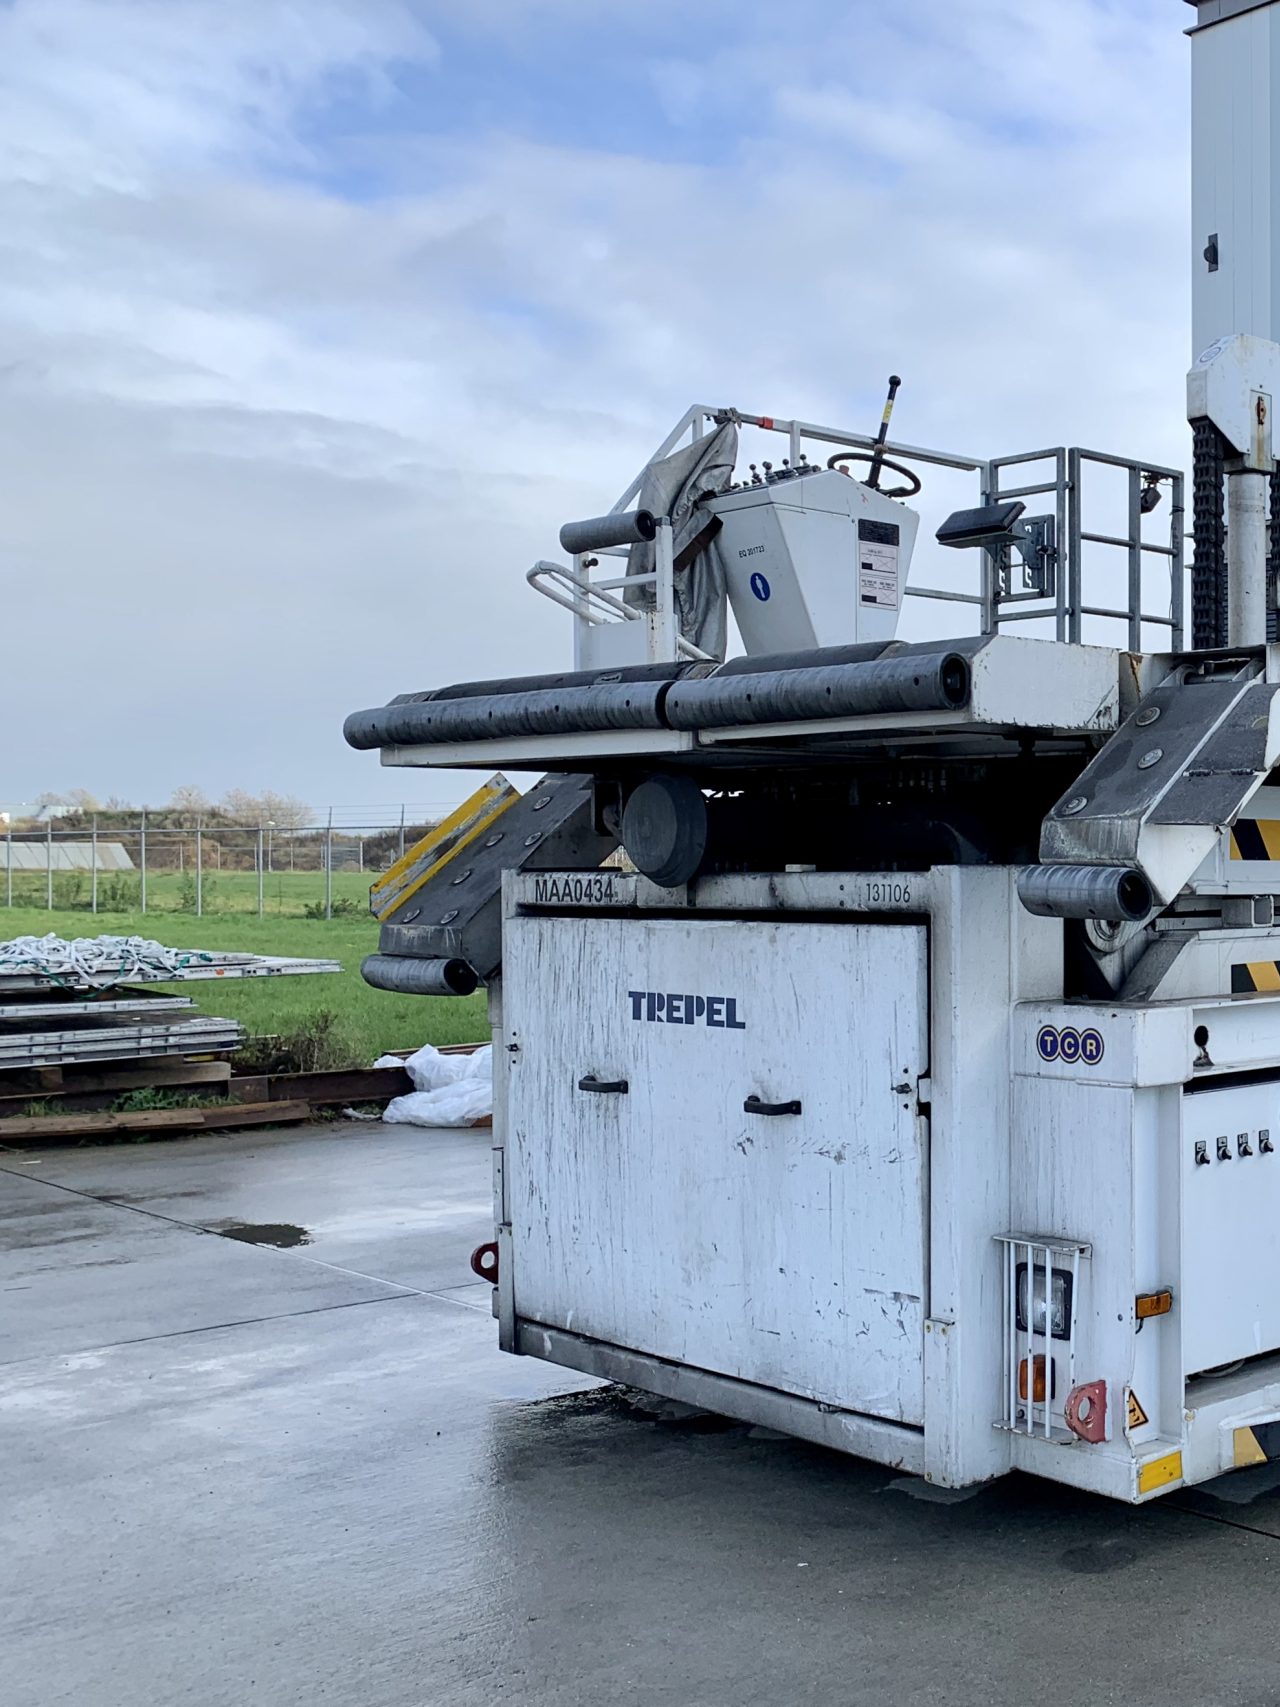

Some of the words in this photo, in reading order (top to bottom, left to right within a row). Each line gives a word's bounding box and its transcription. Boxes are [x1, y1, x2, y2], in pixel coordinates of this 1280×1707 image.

[535, 878, 614, 903] MAA0434
[866, 883, 911, 903] 131106
[628, 990, 746, 1030] TREPEL
